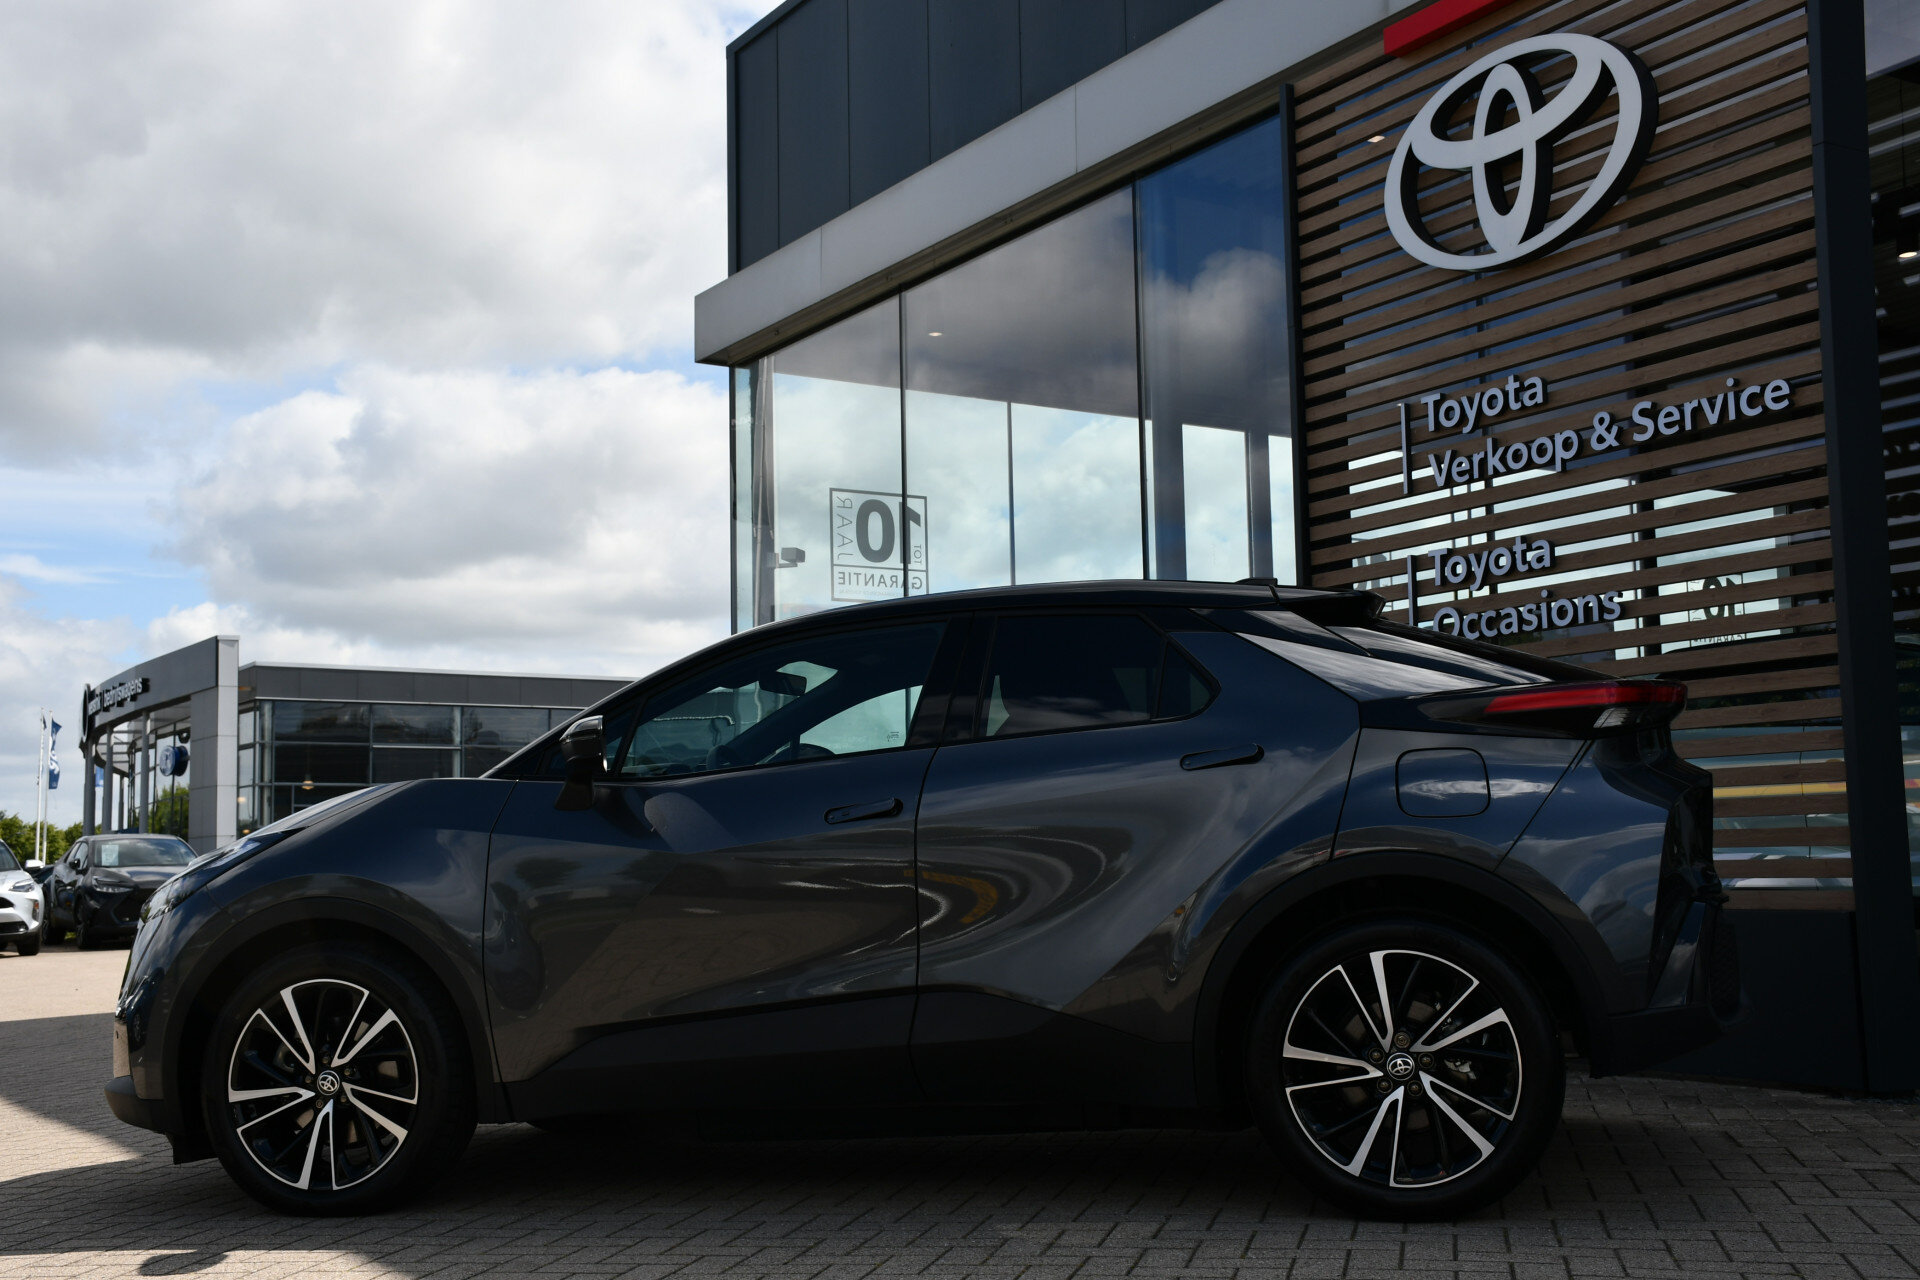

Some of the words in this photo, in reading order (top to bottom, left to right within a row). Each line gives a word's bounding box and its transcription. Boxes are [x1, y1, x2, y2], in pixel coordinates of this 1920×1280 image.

[1421, 374, 1544, 434] Toyota
[1428, 428, 1579, 488] Verkoop
[1590, 411, 1620, 451] &
[1632, 378, 1791, 442] Service
[1428, 536, 1552, 591] Toyota
[1433, 589, 1622, 640] Occasions
